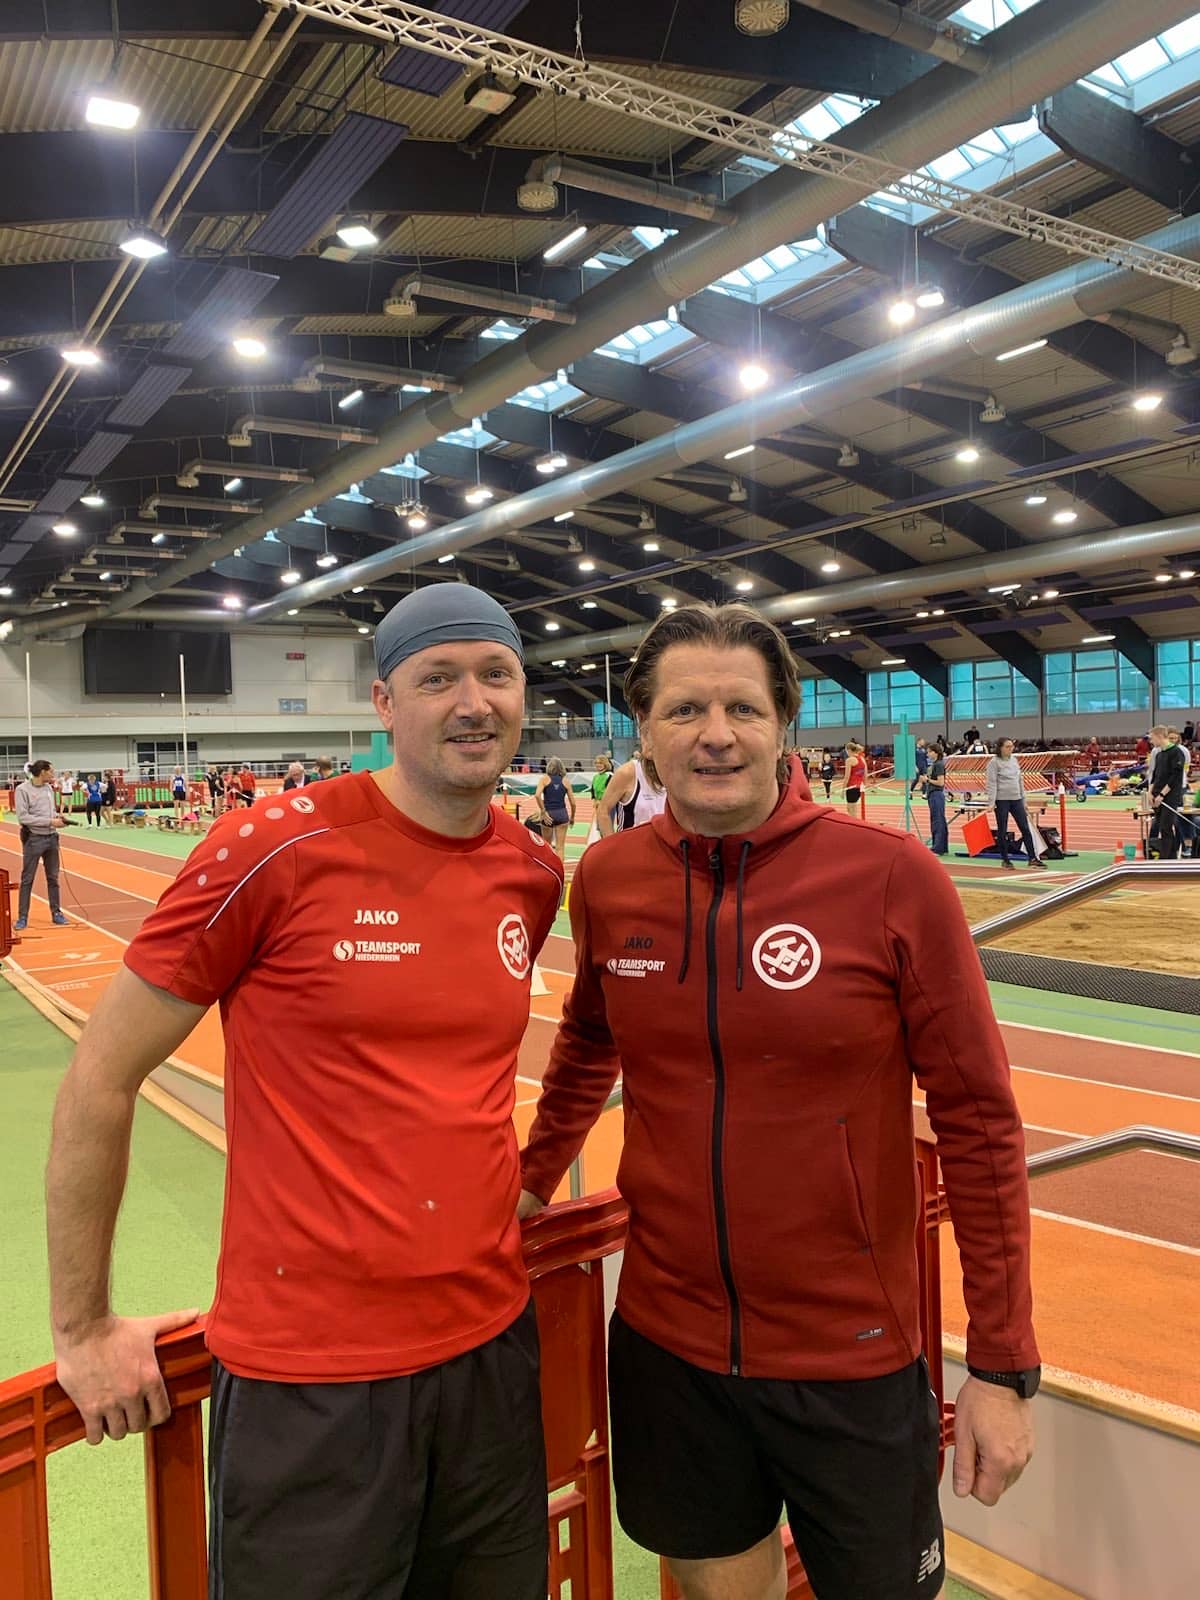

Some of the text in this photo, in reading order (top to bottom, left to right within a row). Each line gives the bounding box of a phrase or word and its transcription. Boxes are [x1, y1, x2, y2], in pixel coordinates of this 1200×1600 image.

[354, 909, 400, 926] JAKO
[355, 940, 422, 955] TEAMSPORT
[623, 936, 654, 950] JAKO
[617, 958, 666, 972] TEAMSPORT
